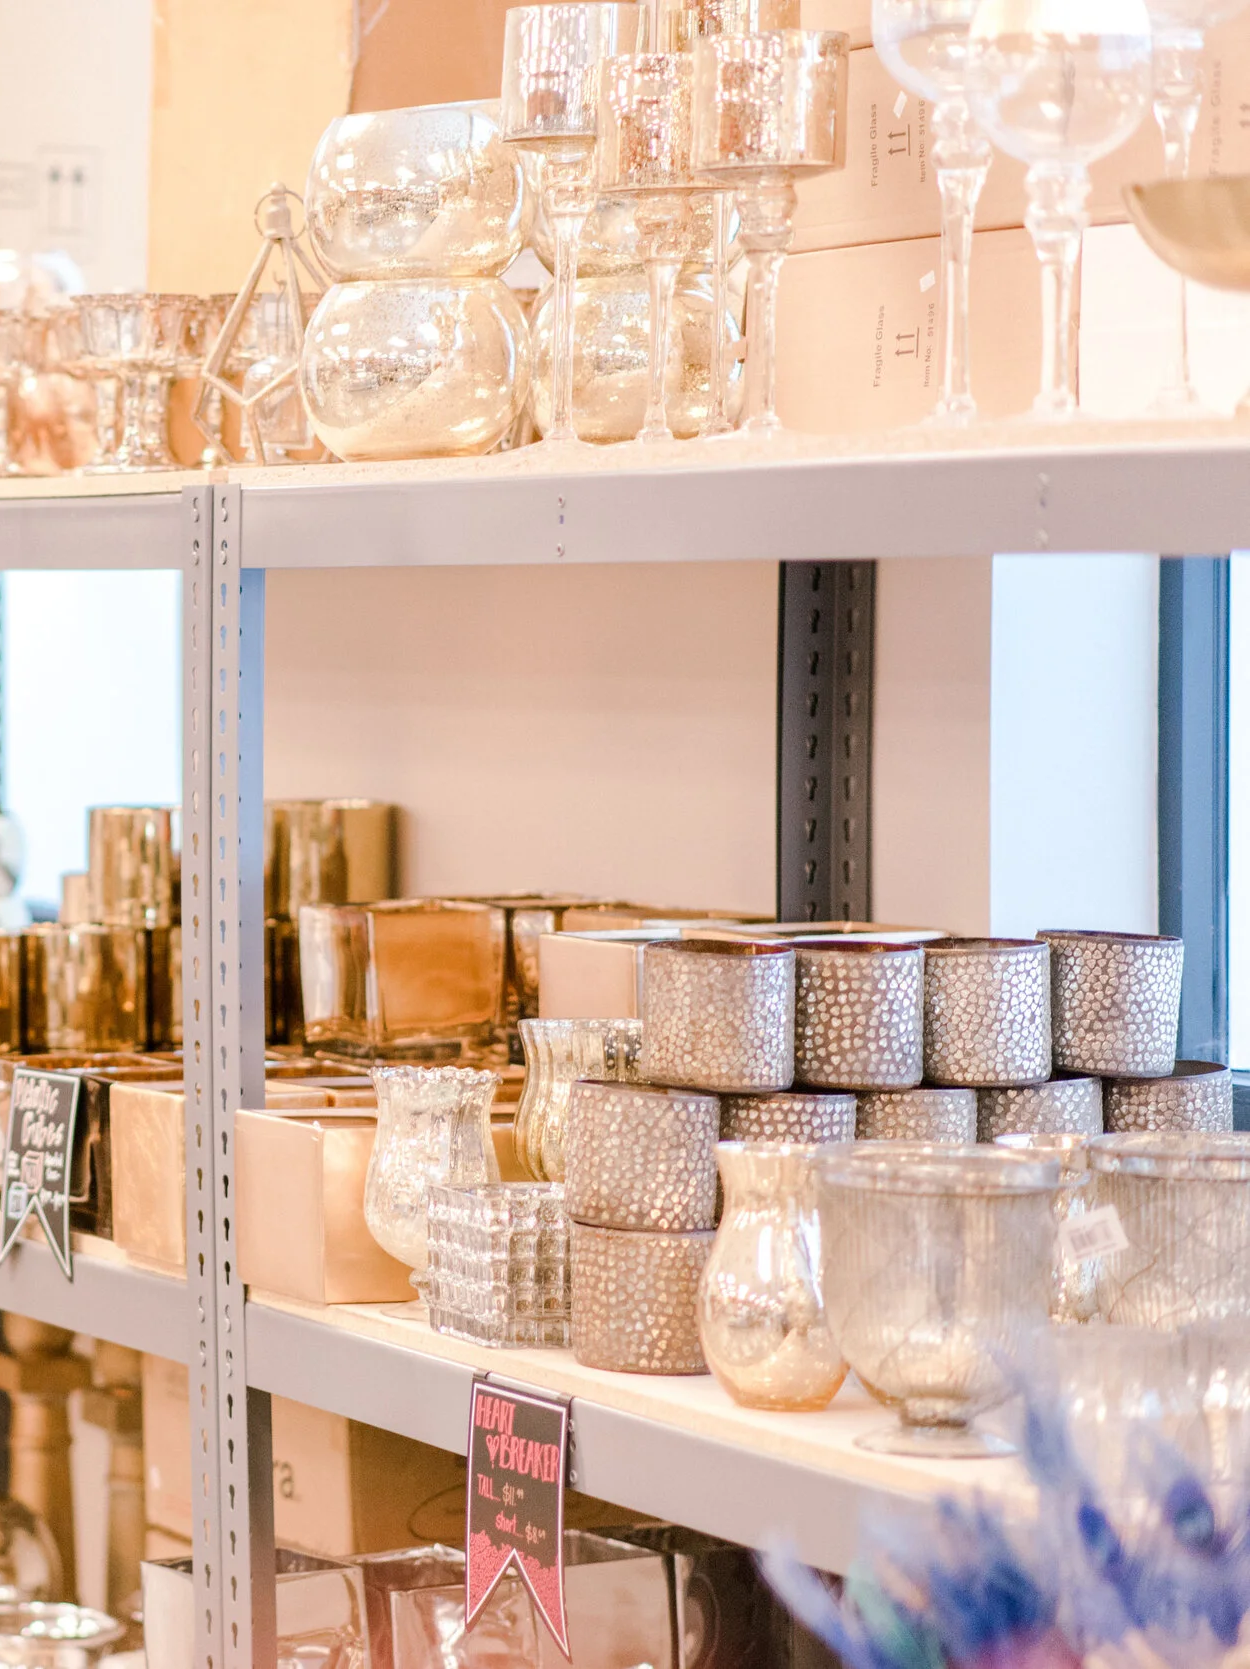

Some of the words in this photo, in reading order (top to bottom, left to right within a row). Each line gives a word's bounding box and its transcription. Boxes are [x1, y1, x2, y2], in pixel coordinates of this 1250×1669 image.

[869, 103, 878, 140] Glass
[870, 143, 879, 188] Fragile
[918, 160, 927, 183] Item
[875, 304, 885, 341] Glass
[873, 344, 883, 388] Fragile
[923, 365, 931, 388] Item
[475, 1394, 516, 1436] HEART
[499, 1434, 560, 1483] BREAKER
